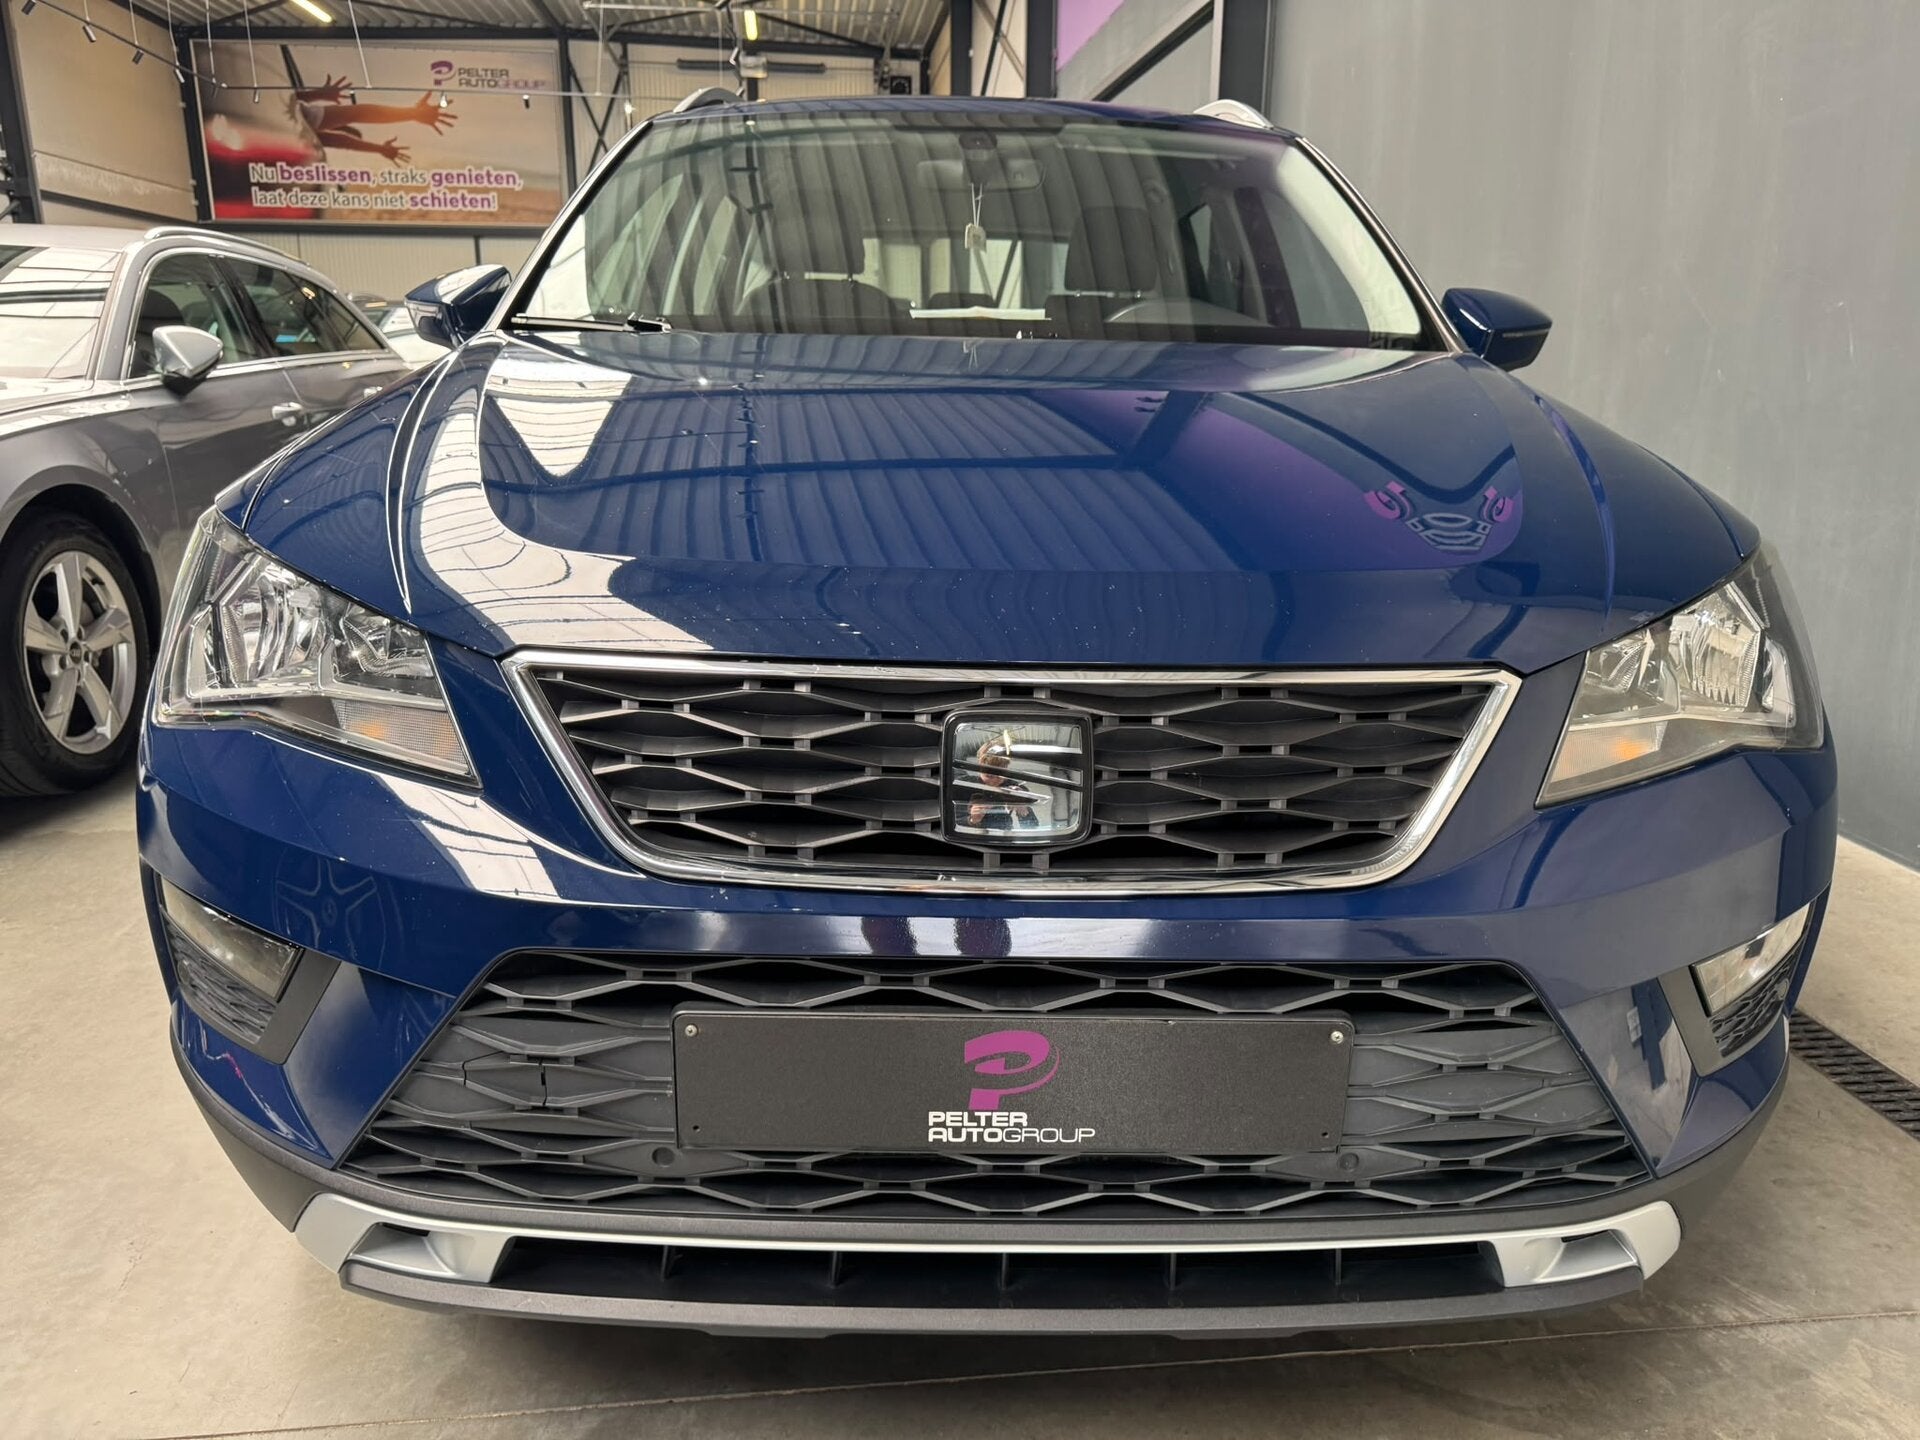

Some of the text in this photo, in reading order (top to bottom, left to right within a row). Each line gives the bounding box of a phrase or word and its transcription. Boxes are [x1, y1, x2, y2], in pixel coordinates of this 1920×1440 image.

[458, 67, 510, 78] PELTER
[250, 163, 522, 188] Nu beslissen, straks genieten,
[253, 188, 497, 209] laat deze kans niet schieten!
[928, 1111, 1028, 1127] PELTER
[928, 1127, 1096, 1143] AUTOGROUP
